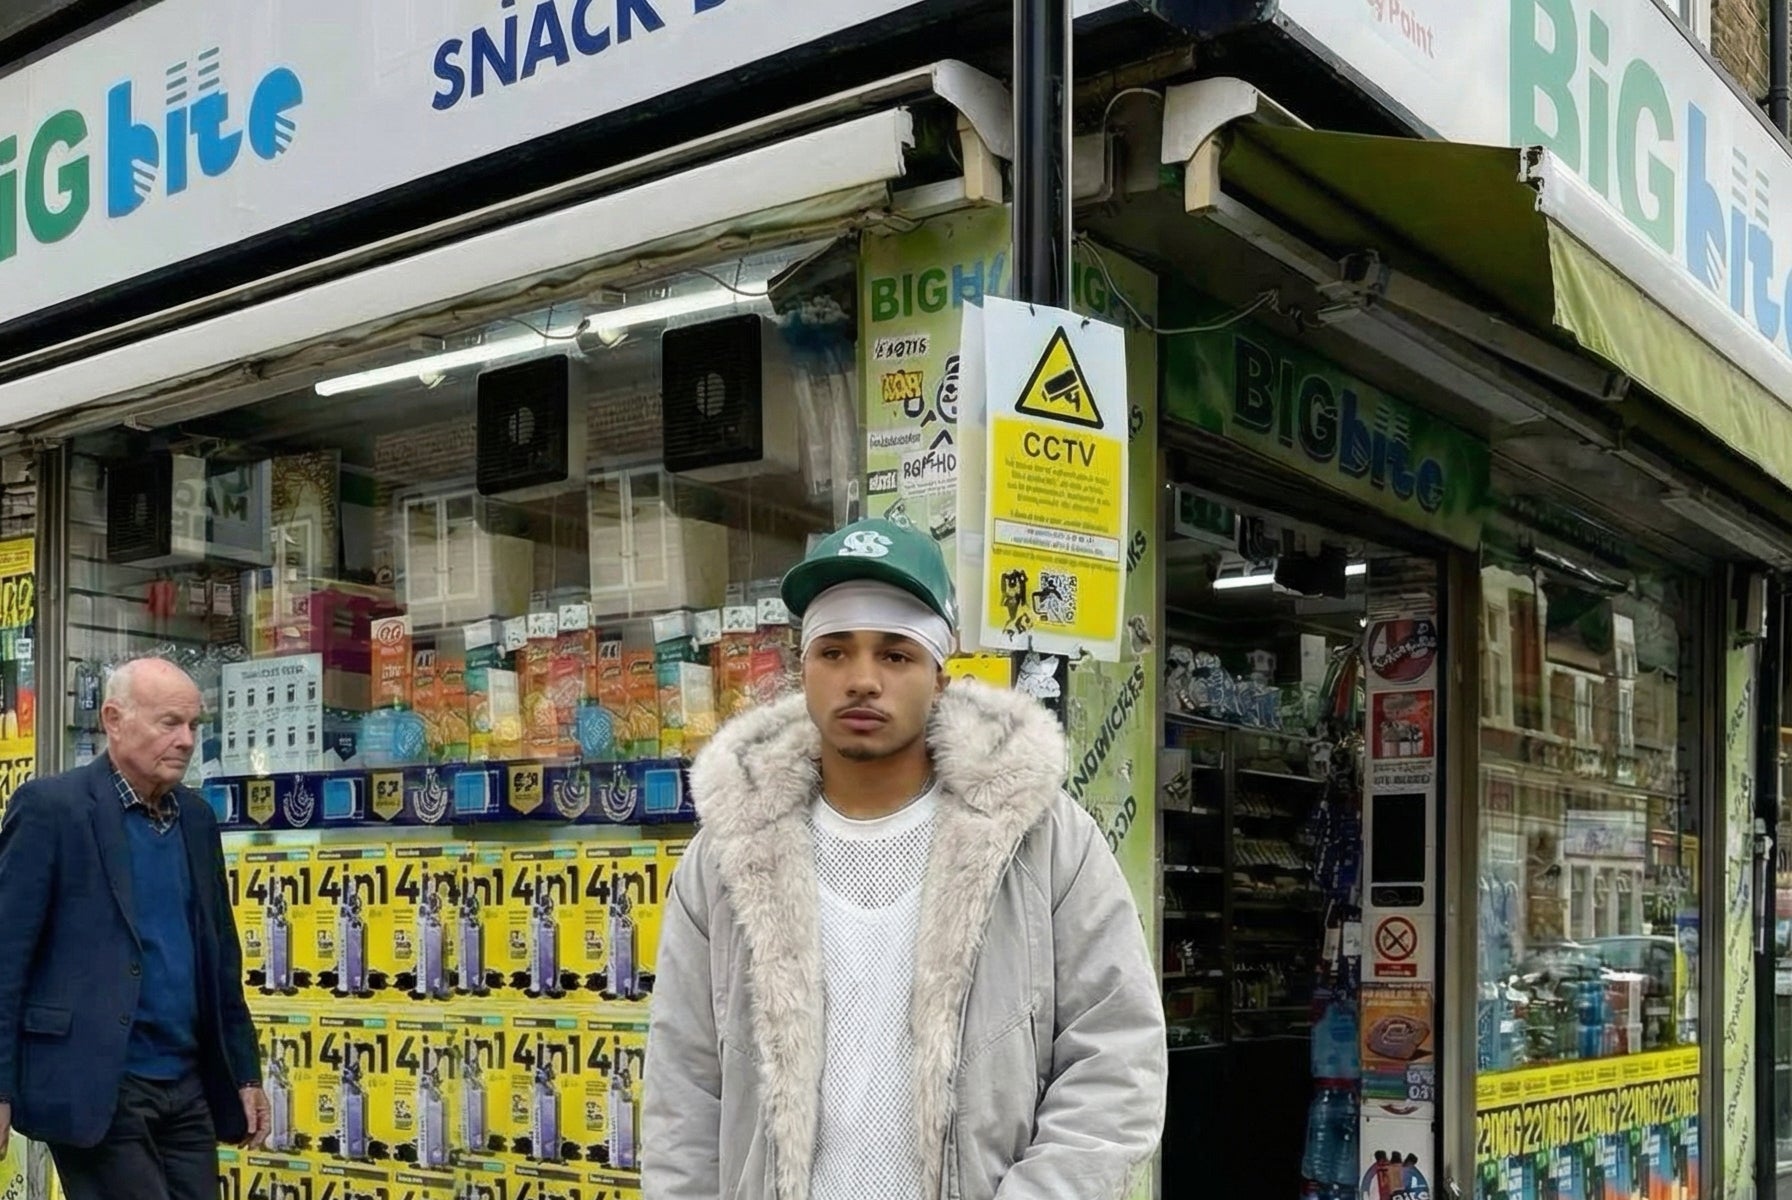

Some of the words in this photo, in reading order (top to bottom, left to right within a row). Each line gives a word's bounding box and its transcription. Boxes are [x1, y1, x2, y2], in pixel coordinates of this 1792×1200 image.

[431, 0, 666, 111] SNACK
[1024, 431, 1096, 467] CCTV
[246, 865, 311, 905] 4in1
[317, 863, 388, 905] 4in1
[511, 863, 579, 906] 4in1
[586, 861, 657, 905] 4in1
[319, 1031, 388, 1074] 4in1
[513, 1032, 581, 1075] 4in1
[588, 1035, 645, 1080] 4in
